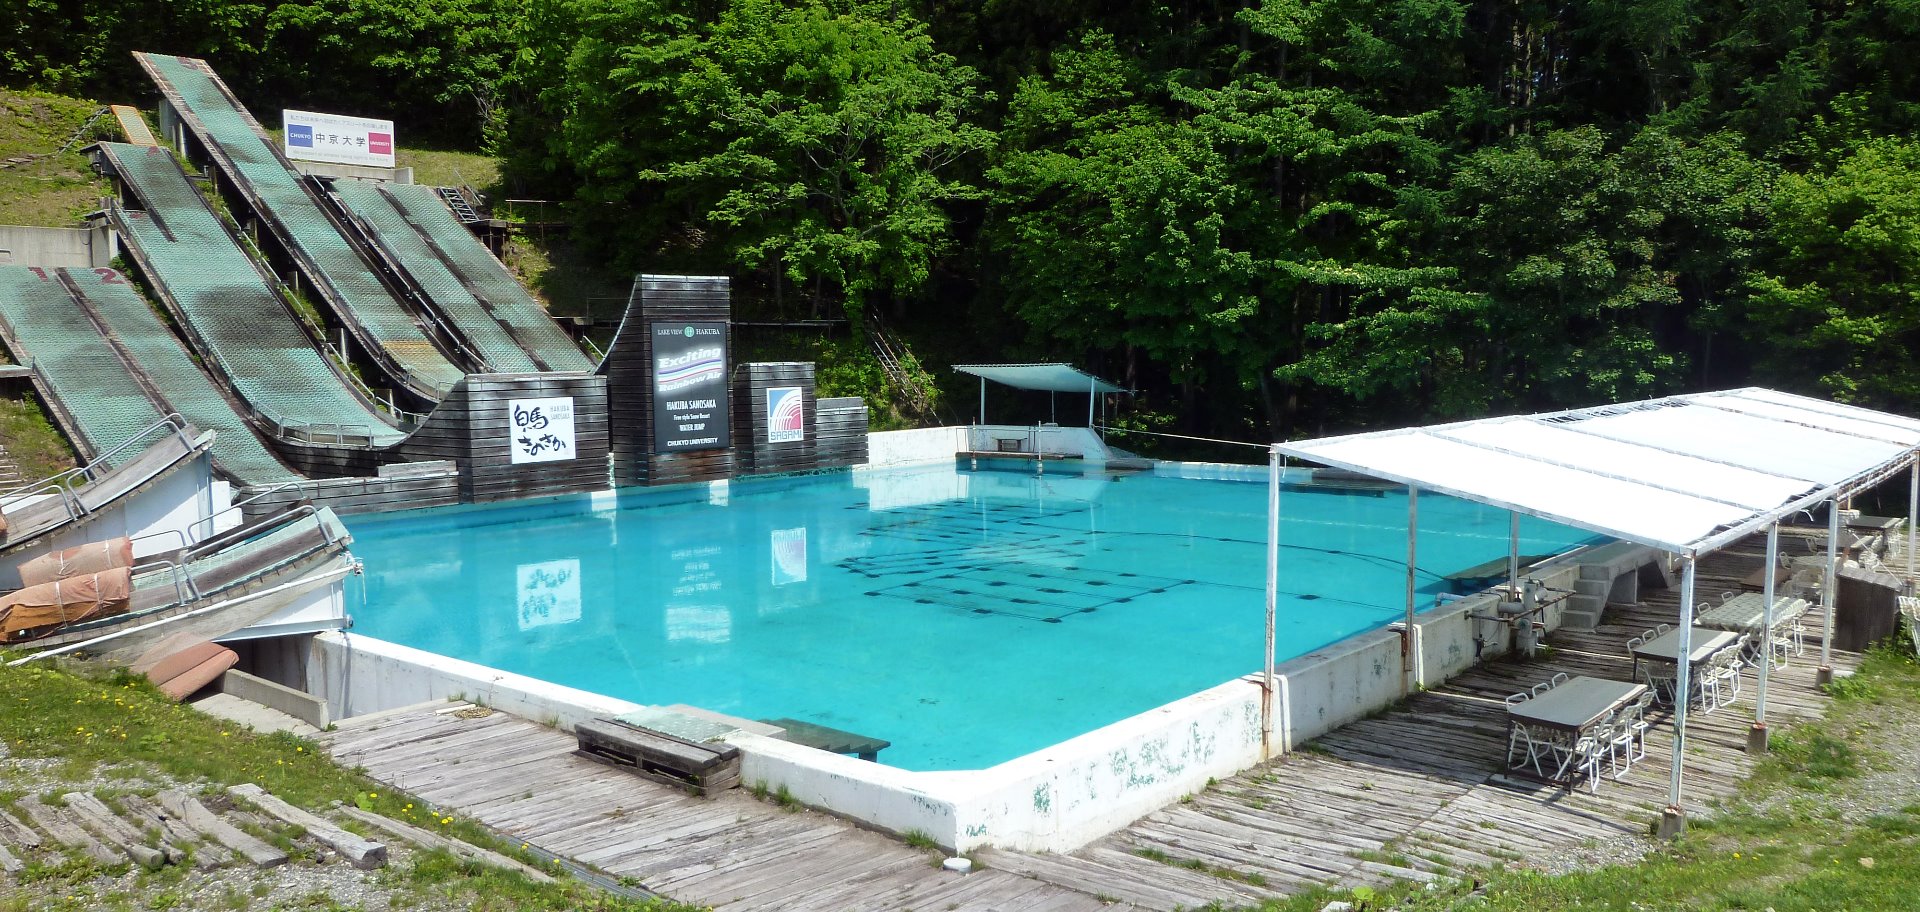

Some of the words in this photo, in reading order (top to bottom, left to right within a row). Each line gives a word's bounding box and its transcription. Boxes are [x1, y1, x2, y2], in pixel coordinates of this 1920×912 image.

[290, 132, 311, 140] CHUKYO
[315, 132, 366, 147] 中京大学
[94, 268, 124, 285] 2
[658, 348, 722, 368] Exciting
[658, 375, 706, 392] Rainbow
[706, 372, 722, 380] Air
[666, 400, 688, 410] HAKUBA
[689, 399, 717, 409] SANOSAKA
[514, 404, 549, 430] 白馬
[689, 437, 718, 445] UNIVERSITY
[770, 430, 802, 440] SAGAMI
